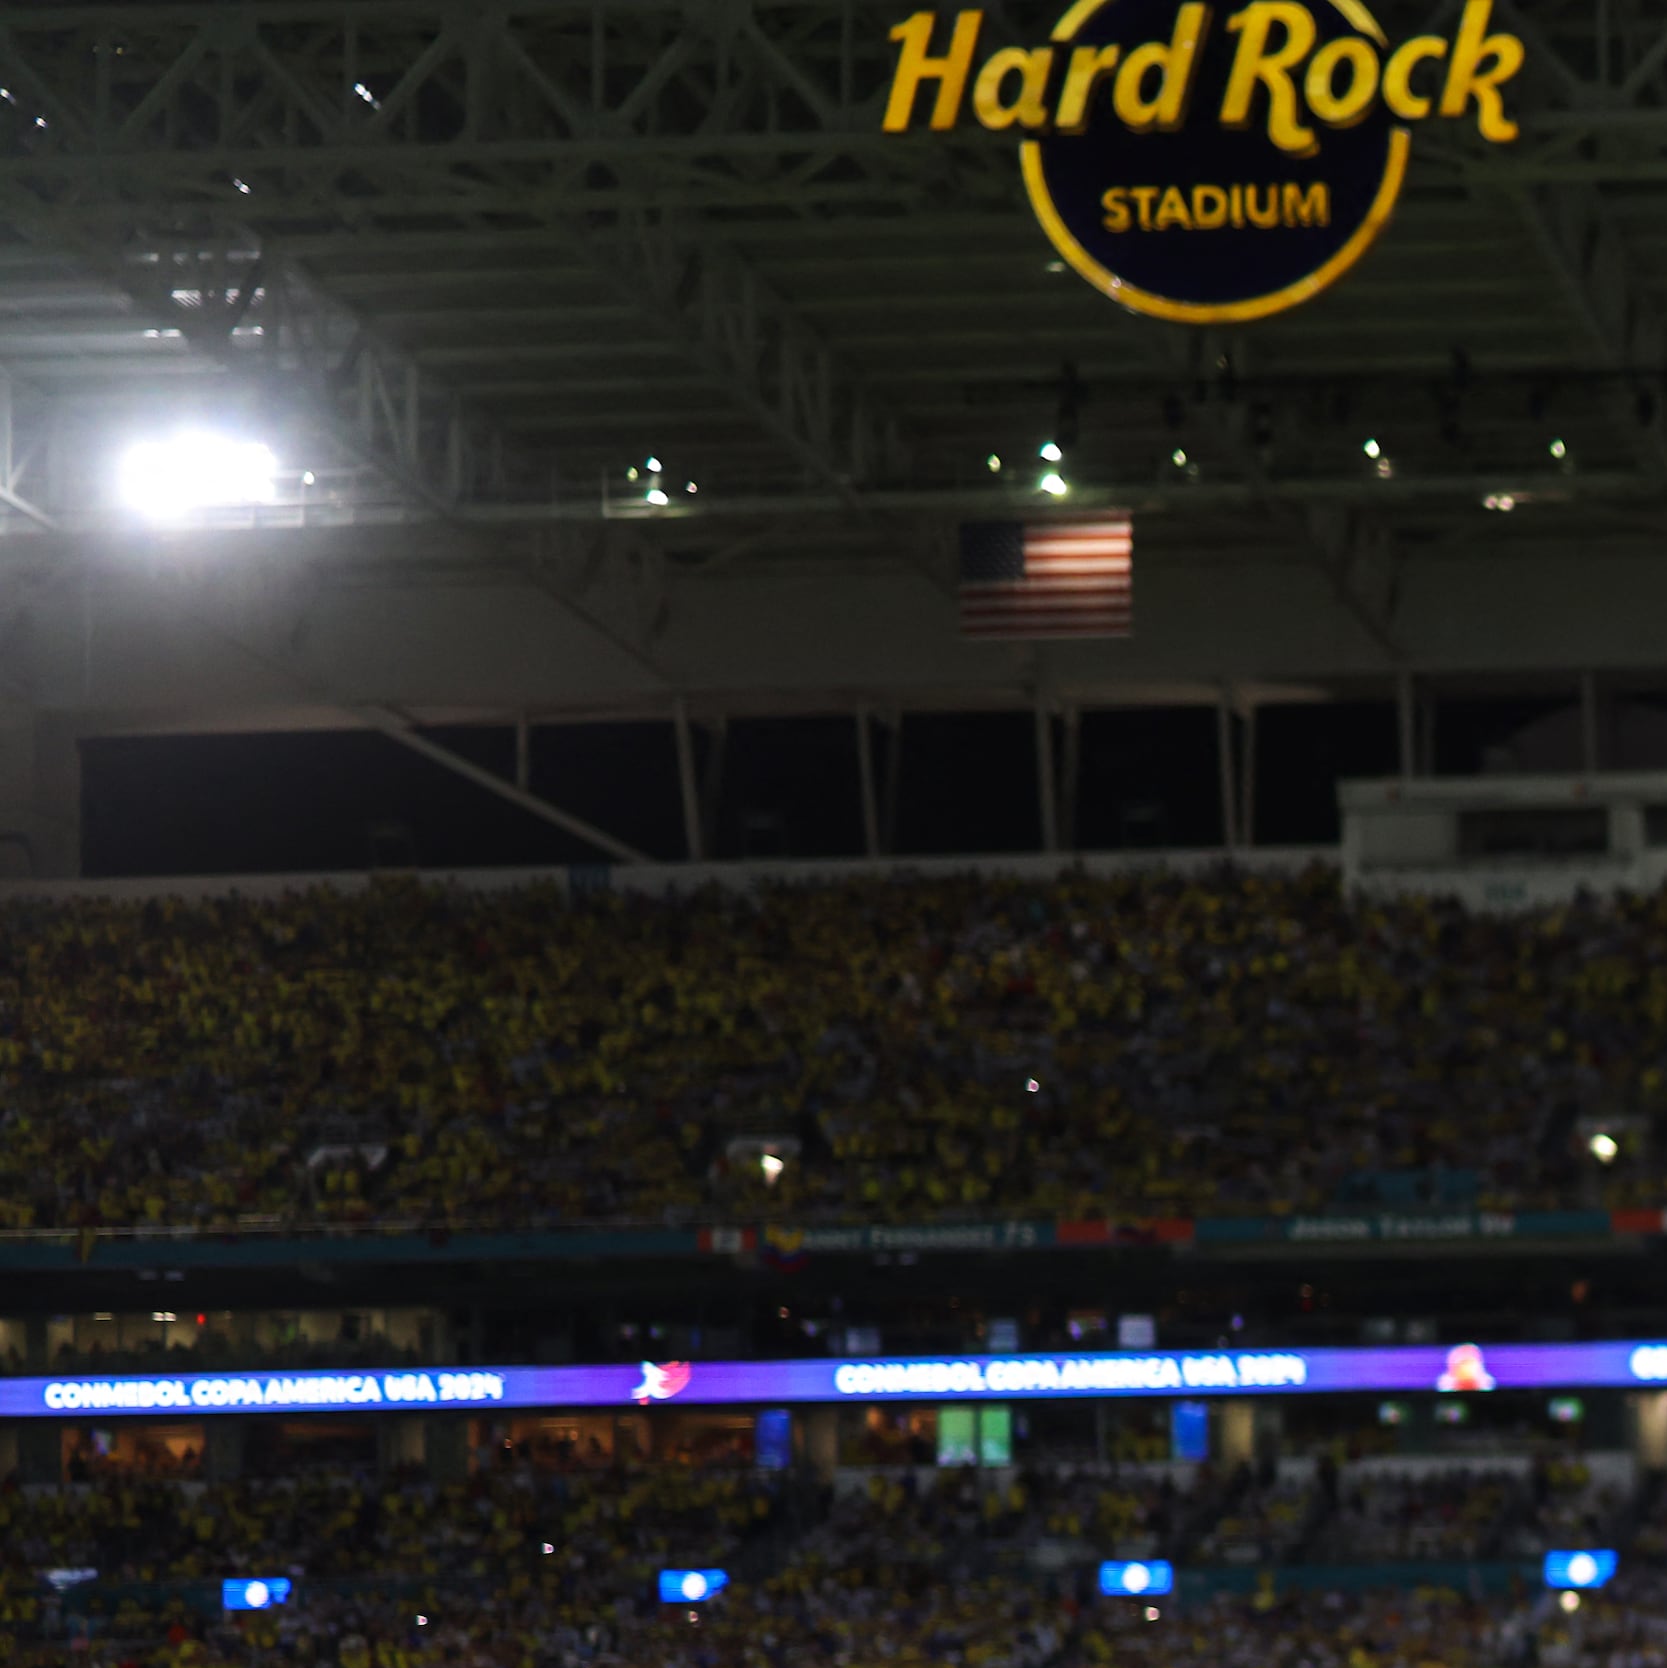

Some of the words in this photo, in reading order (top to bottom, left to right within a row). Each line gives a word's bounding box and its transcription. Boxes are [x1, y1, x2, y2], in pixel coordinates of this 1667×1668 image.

[882, 1, 1206, 131] Hard
[1219, 0, 1525, 156] Rock
[1101, 183, 1331, 231] STADIUM
[45, 1381, 190, 1409] CONMEBOL
[192, 1380, 263, 1406] COPA
[264, 1376, 382, 1404] AMERICA
[385, 1374, 437, 1402] USA
[439, 1373, 503, 1401] 2024
